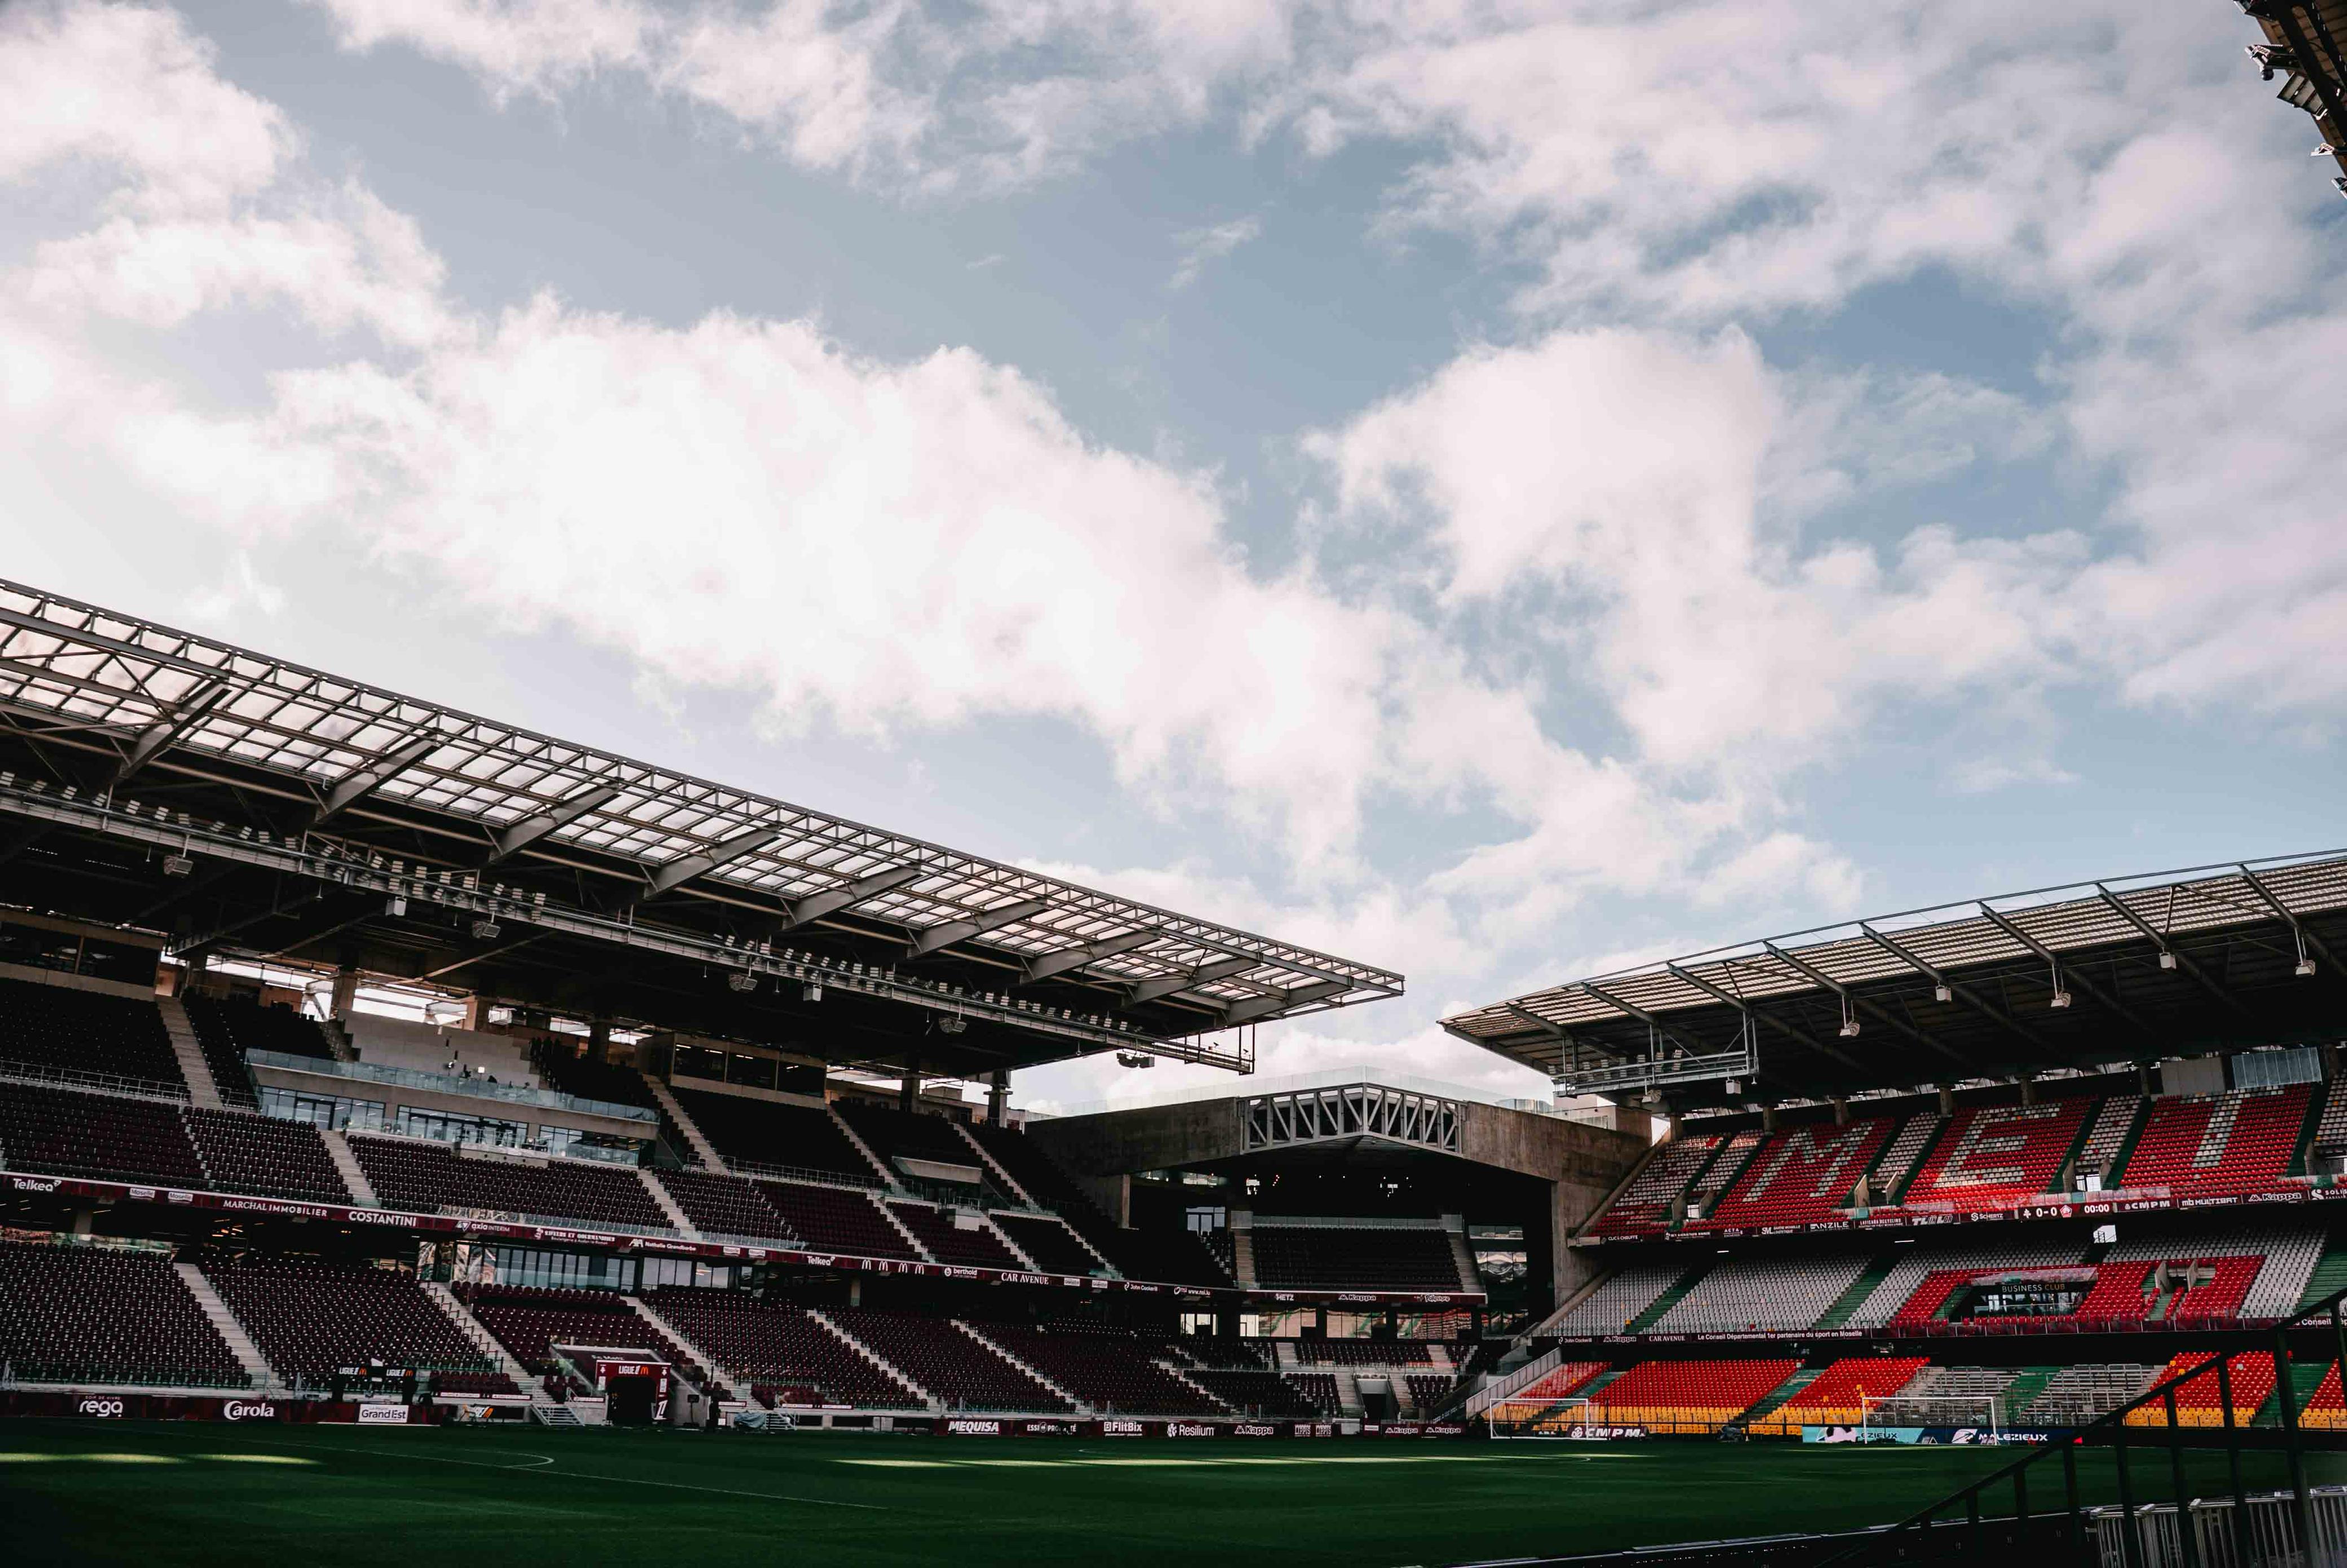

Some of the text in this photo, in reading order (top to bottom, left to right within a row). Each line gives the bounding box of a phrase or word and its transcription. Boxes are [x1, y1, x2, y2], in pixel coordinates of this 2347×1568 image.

[13, 1178, 54, 1192] Telkea
[2262, 1192, 2301, 1201] Kappa
[223, 1200, 327, 1216] MARCHAL IMMOBILIER
[2084, 1204, 2110, 1214] 00:00
[2131, 1200, 2170, 1210] CMPM
[348, 1211, 417, 1227] COSTANTINI
[807, 1255, 832, 1267] Telkea
[953, 1267, 978, 1276] berthold
[1001, 1272, 1049, 1285] CAR AVENUE
[2002, 1284, 2042, 1293] BUSINESS
[223, 1400, 275, 1420] Carola
[362, 1409, 406, 1418] Grand Est
[948, 1421, 999, 1432] MEQUISA
[1112, 1421, 1142, 1432] FlitBix
[1179, 1424, 1215, 1437] Resilium
[1245, 1426, 1274, 1436] Kappa
[1394, 1426, 1419, 1434] Kappa
[1434, 1426, 1461, 1434] Kappa
